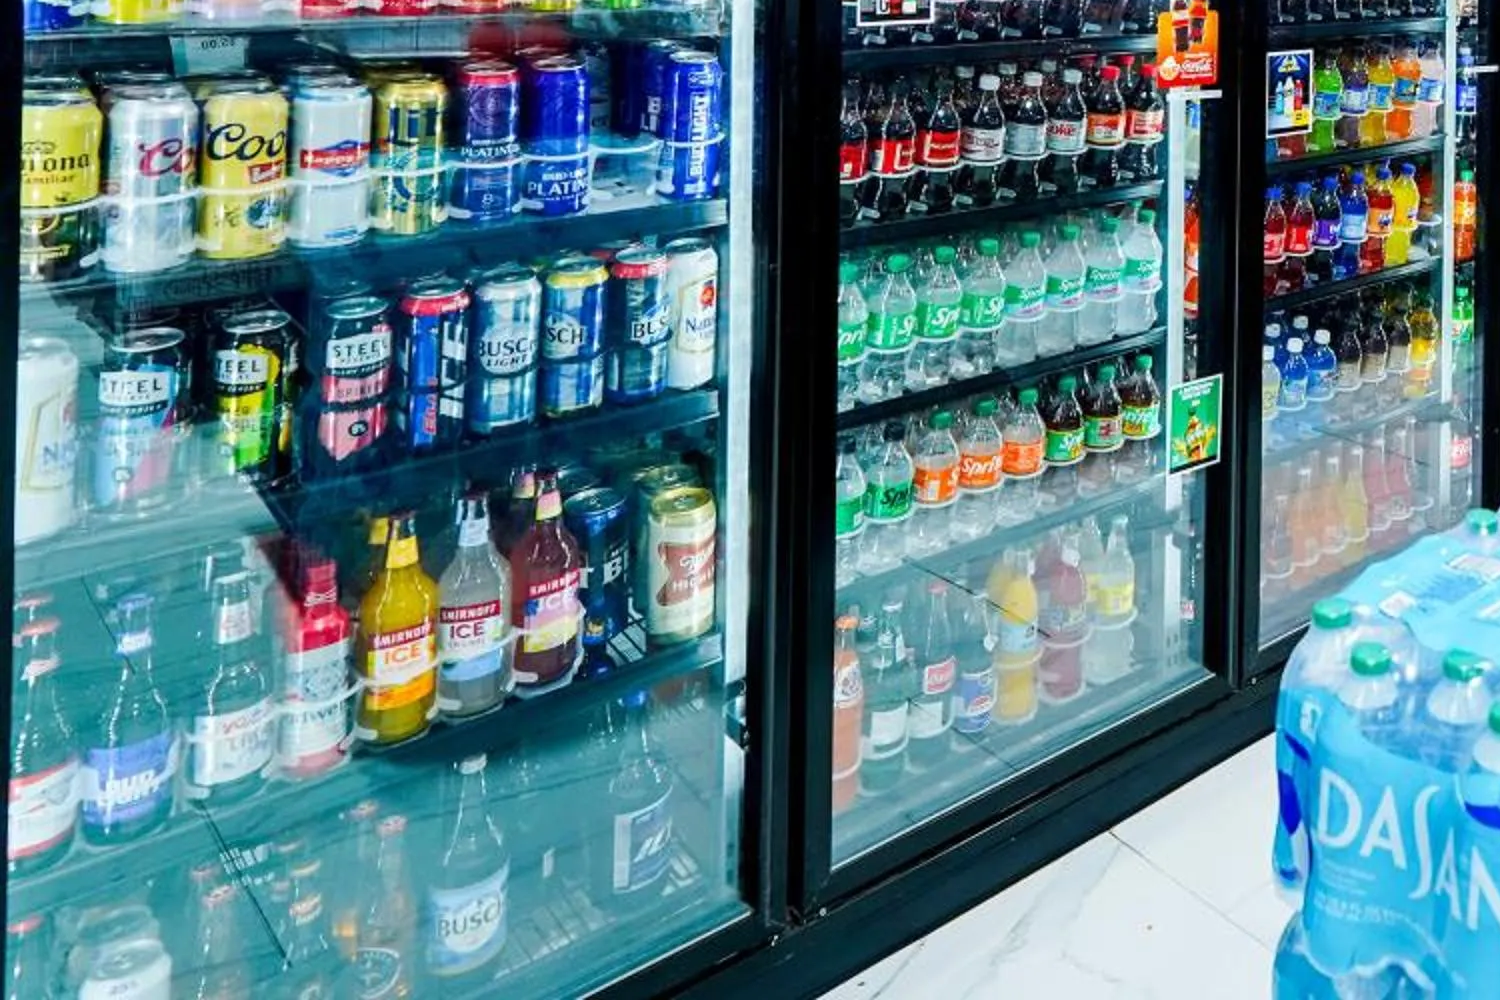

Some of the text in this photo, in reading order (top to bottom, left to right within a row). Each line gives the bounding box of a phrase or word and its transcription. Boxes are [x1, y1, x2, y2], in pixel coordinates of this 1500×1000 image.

[547, 325, 586, 346] SCH
[332, 338, 390, 358] STEEL
[215, 357, 262, 374] TEEL
[484, 354, 530, 369] LIGHT
[441, 602, 500, 623] SMIRNOFF
[449, 623, 486, 641] ICE
[384, 646, 423, 666] ICE
